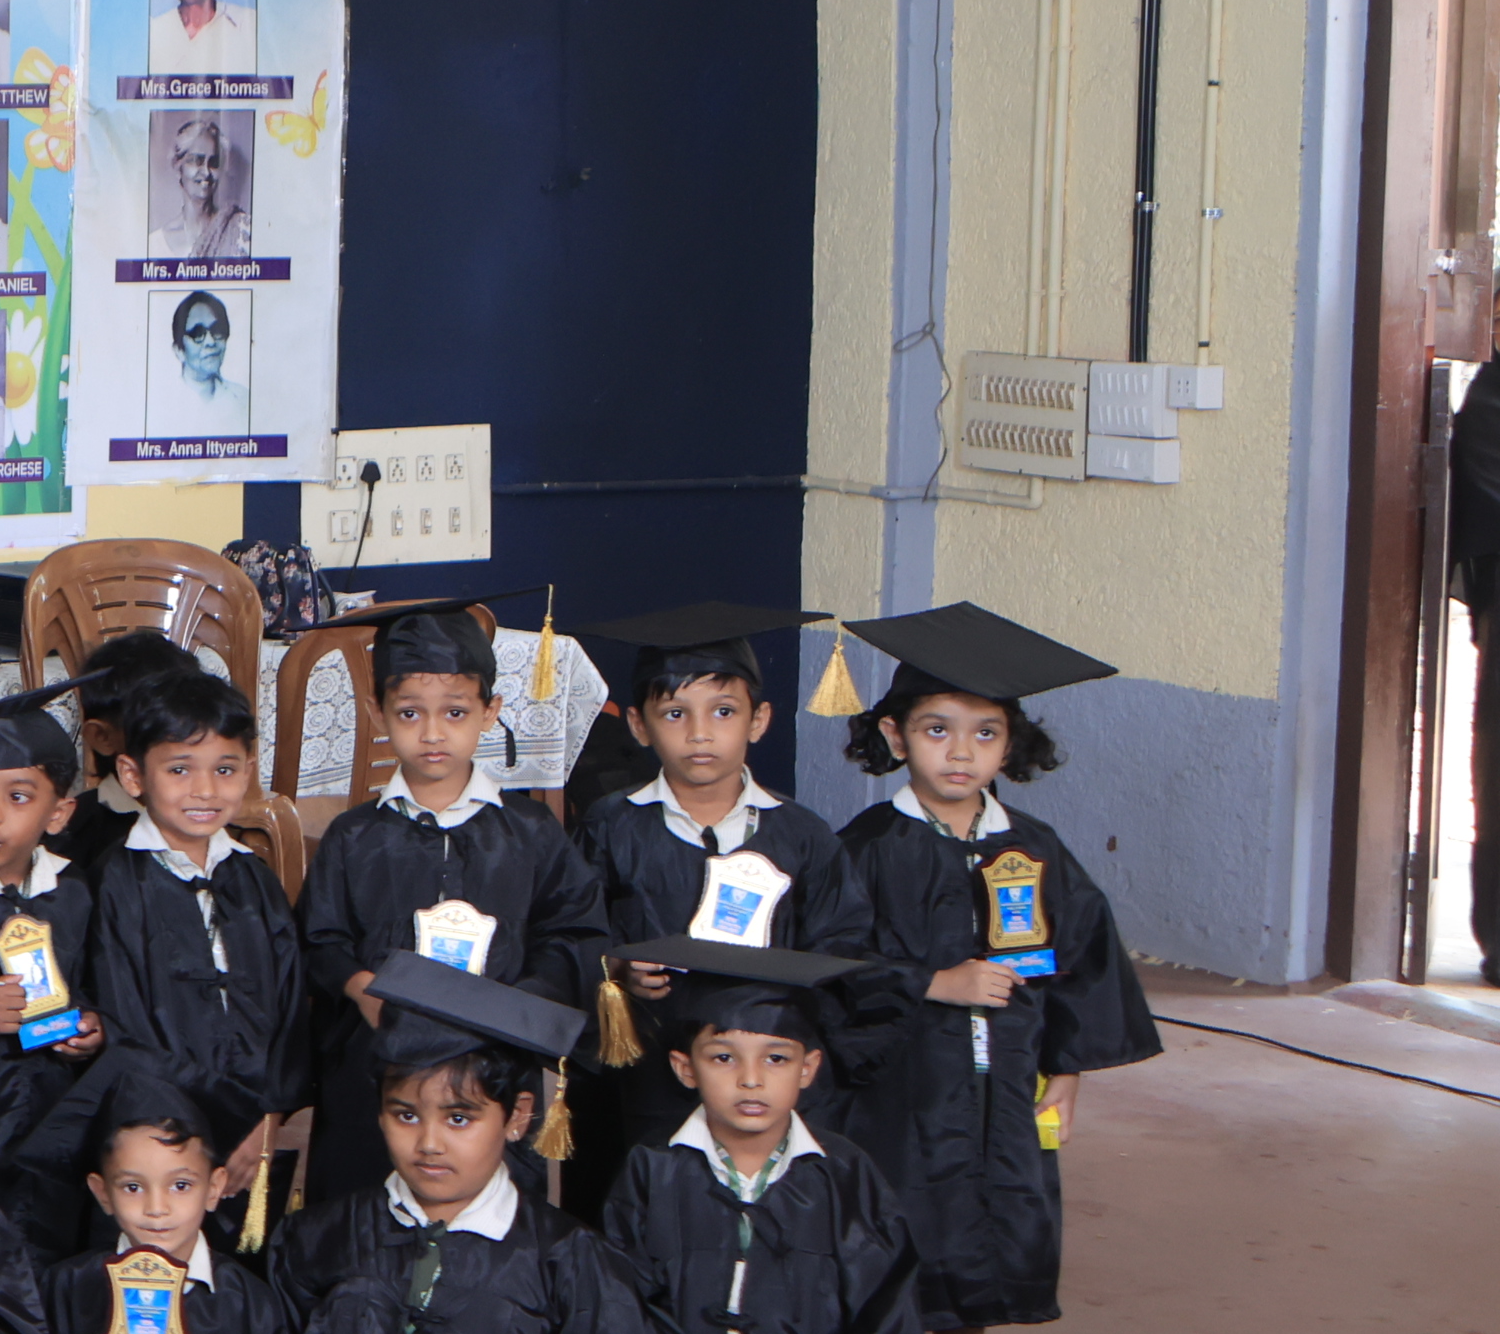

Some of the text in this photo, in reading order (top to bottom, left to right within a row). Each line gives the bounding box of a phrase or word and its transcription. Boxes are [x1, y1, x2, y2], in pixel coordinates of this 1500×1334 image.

[213, 79, 269, 96] Thomas
[142, 261, 261, 280] Mrs. Anna Joseph
[137, 439, 259, 458] Mrs. Anna Ittyerah
